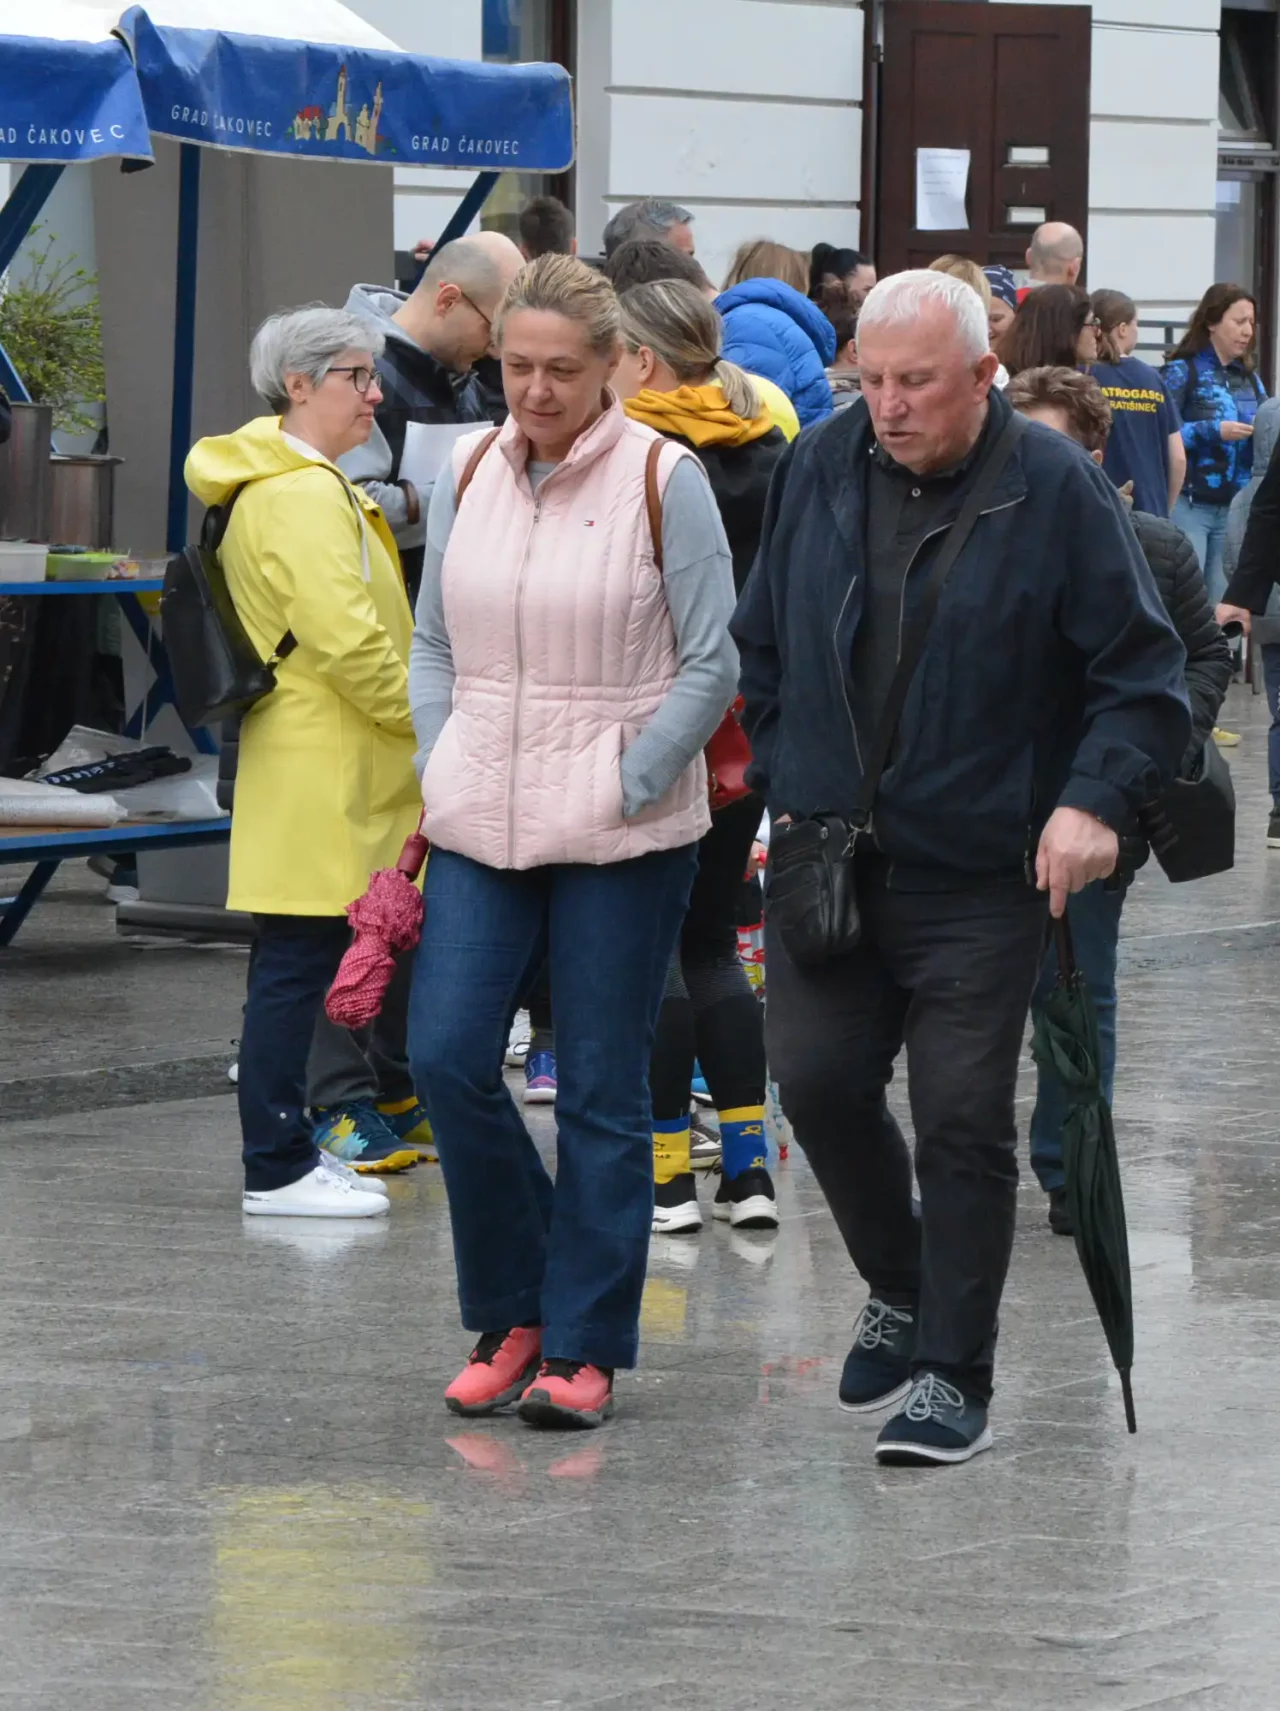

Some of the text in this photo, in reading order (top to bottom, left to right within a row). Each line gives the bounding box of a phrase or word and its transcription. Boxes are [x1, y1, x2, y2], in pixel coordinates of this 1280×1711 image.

[171, 104, 209, 126] GRAD
[28, 124, 125, 144] ČAKOVEC
[411, 135, 519, 155] GRAD ČAKOVEC
